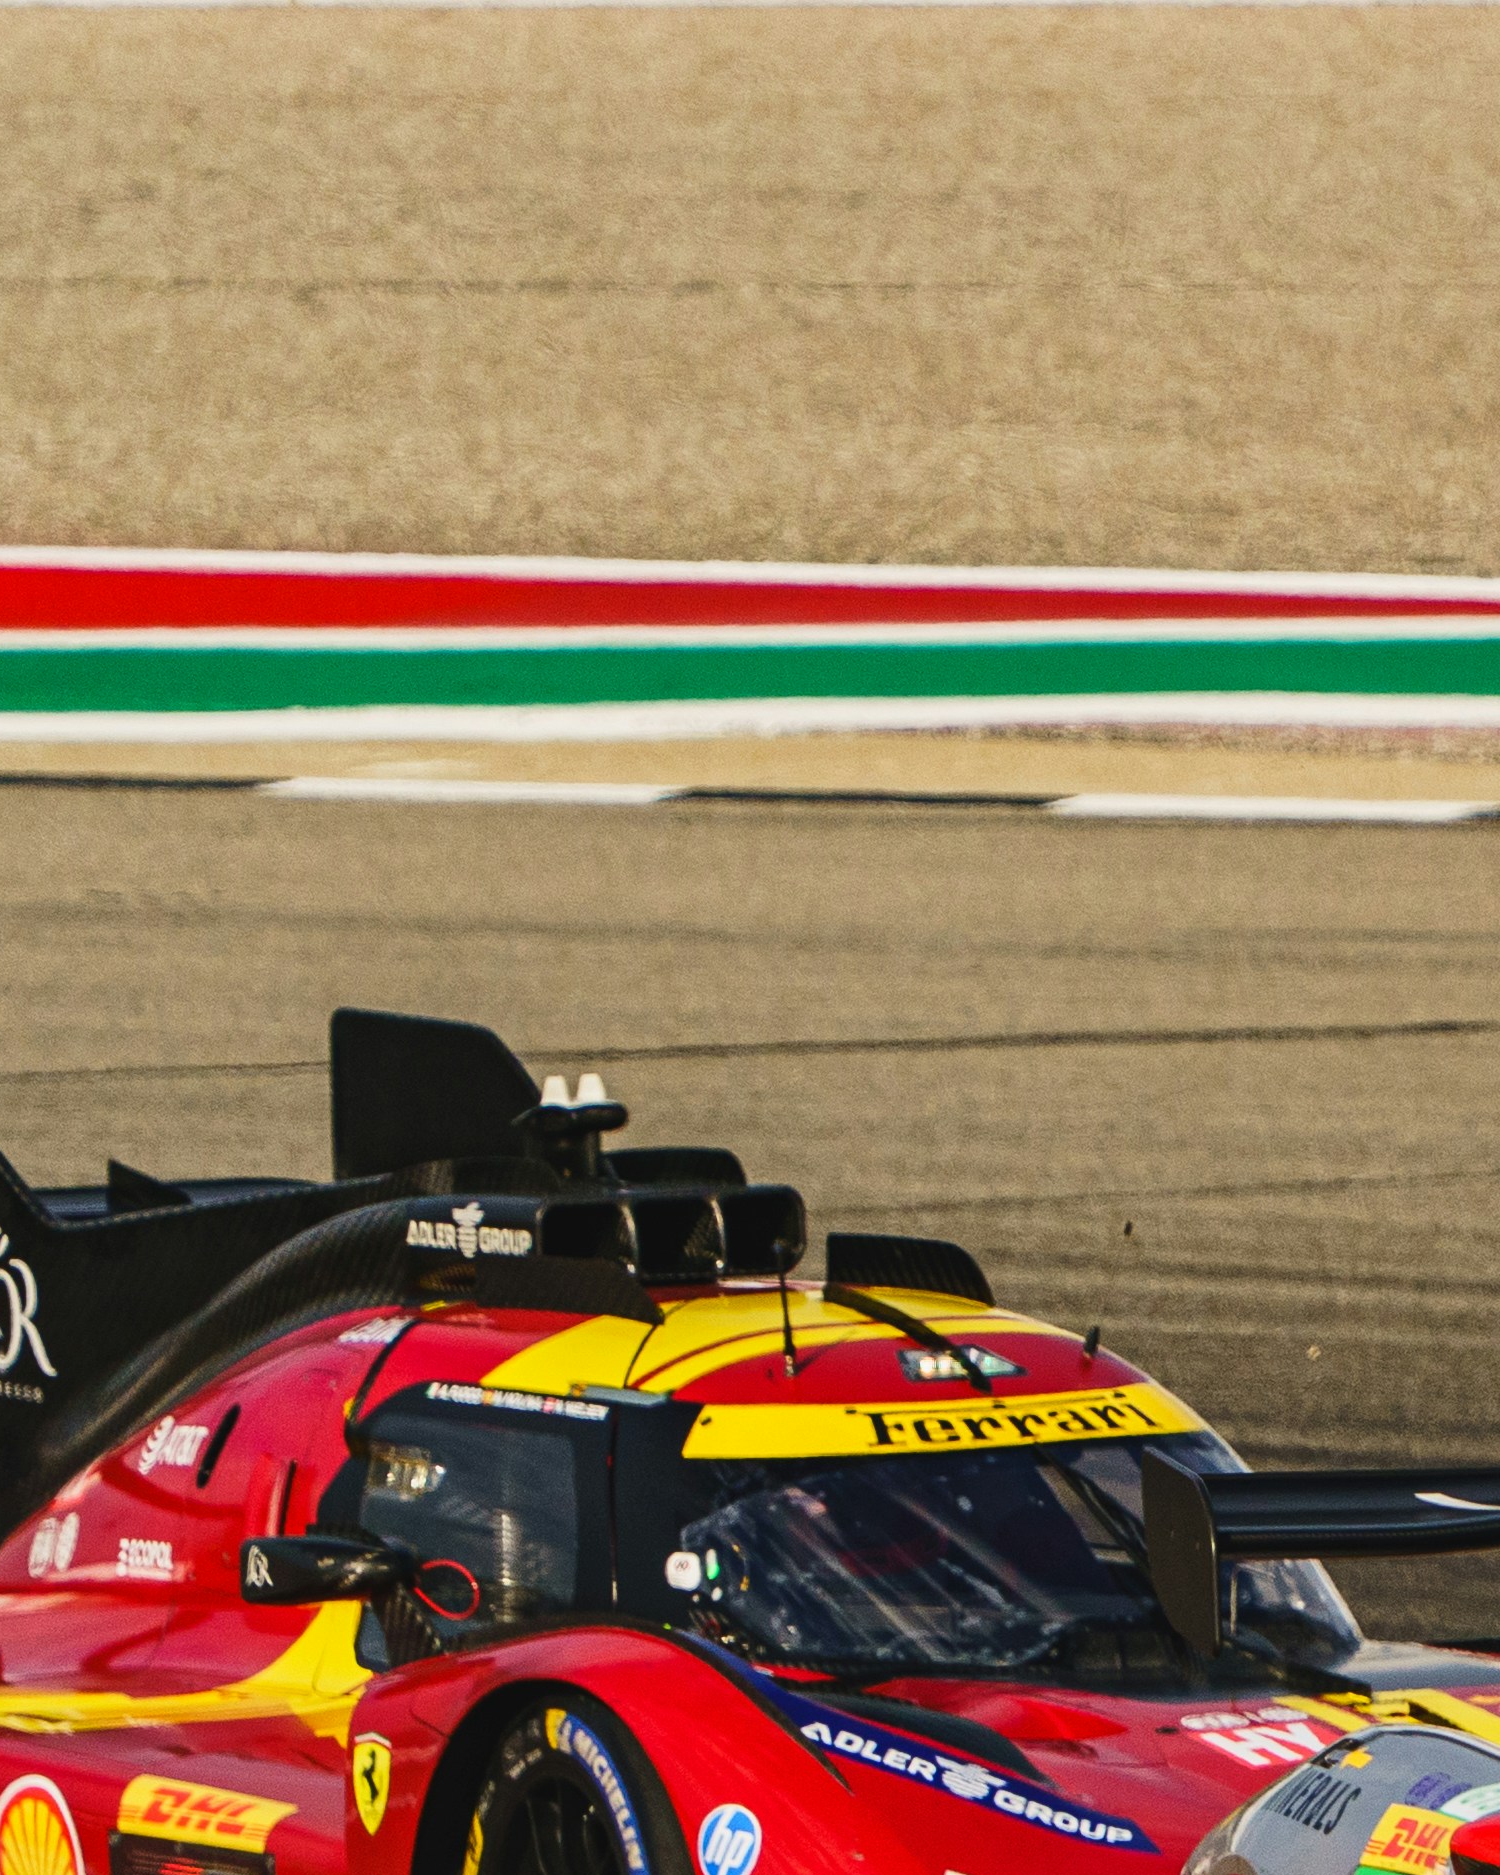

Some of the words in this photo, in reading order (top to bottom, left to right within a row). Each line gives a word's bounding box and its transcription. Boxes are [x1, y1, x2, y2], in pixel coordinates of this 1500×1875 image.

[406, 1219, 458, 1250] ADLER
[478, 1226, 533, 1257] GROUP
[866, 1391, 1159, 1448] Ferrari
[799, 1721, 937, 1782] ADLER
[993, 1790, 1134, 1844] GROUP
[142, 1786, 258, 1836] DHL
[1384, 1817, 1452, 1869] DHL
